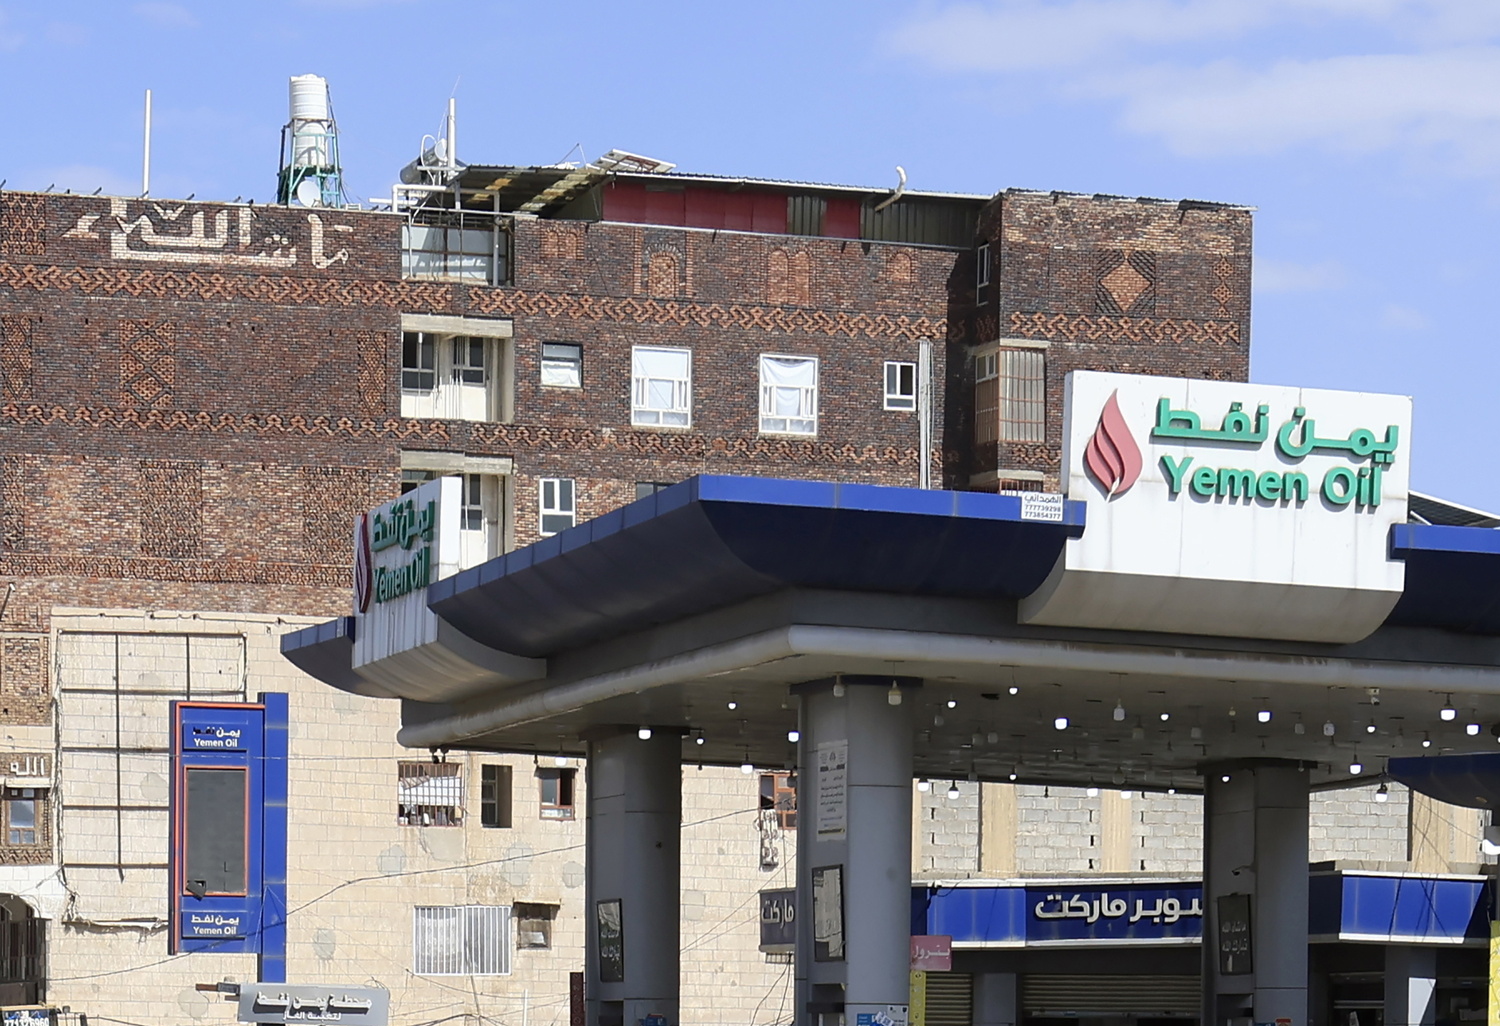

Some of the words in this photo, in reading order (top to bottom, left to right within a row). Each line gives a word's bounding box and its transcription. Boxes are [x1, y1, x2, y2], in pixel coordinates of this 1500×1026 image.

[1151, 397, 1270, 442] نفط
[1278, 406, 1399, 463] يمن
[1159, 455, 1309, 501] Yemen
[1324, 466, 1382, 506] Oil
[371, 504, 404, 552] نفط
[400, 499, 435, 550] يمن
[373, 565, 411, 604] Yemen
[410, 546, 430, 590] Oil
[215, 727, 241, 738] يمن
[193, 738, 223, 747] Yemen
[225, 738, 238, 747] Oil
[10, 756, 45, 776] الله
[761, 899, 795, 929] ماركت
[1035, 893, 1128, 923] ماركت
[191, 915, 214, 923] نفط
[215, 915, 240, 926] يمن
[193, 926, 222, 935] Yemen
[224, 926, 237, 935] Oil
[913, 944, 951, 960] بترول
[257, 992, 290, 1006] نفط
[293, 996, 326, 1010] يمن
[329, 994, 372, 1009] محطة
[282, 1010, 306, 1020] الغاز
